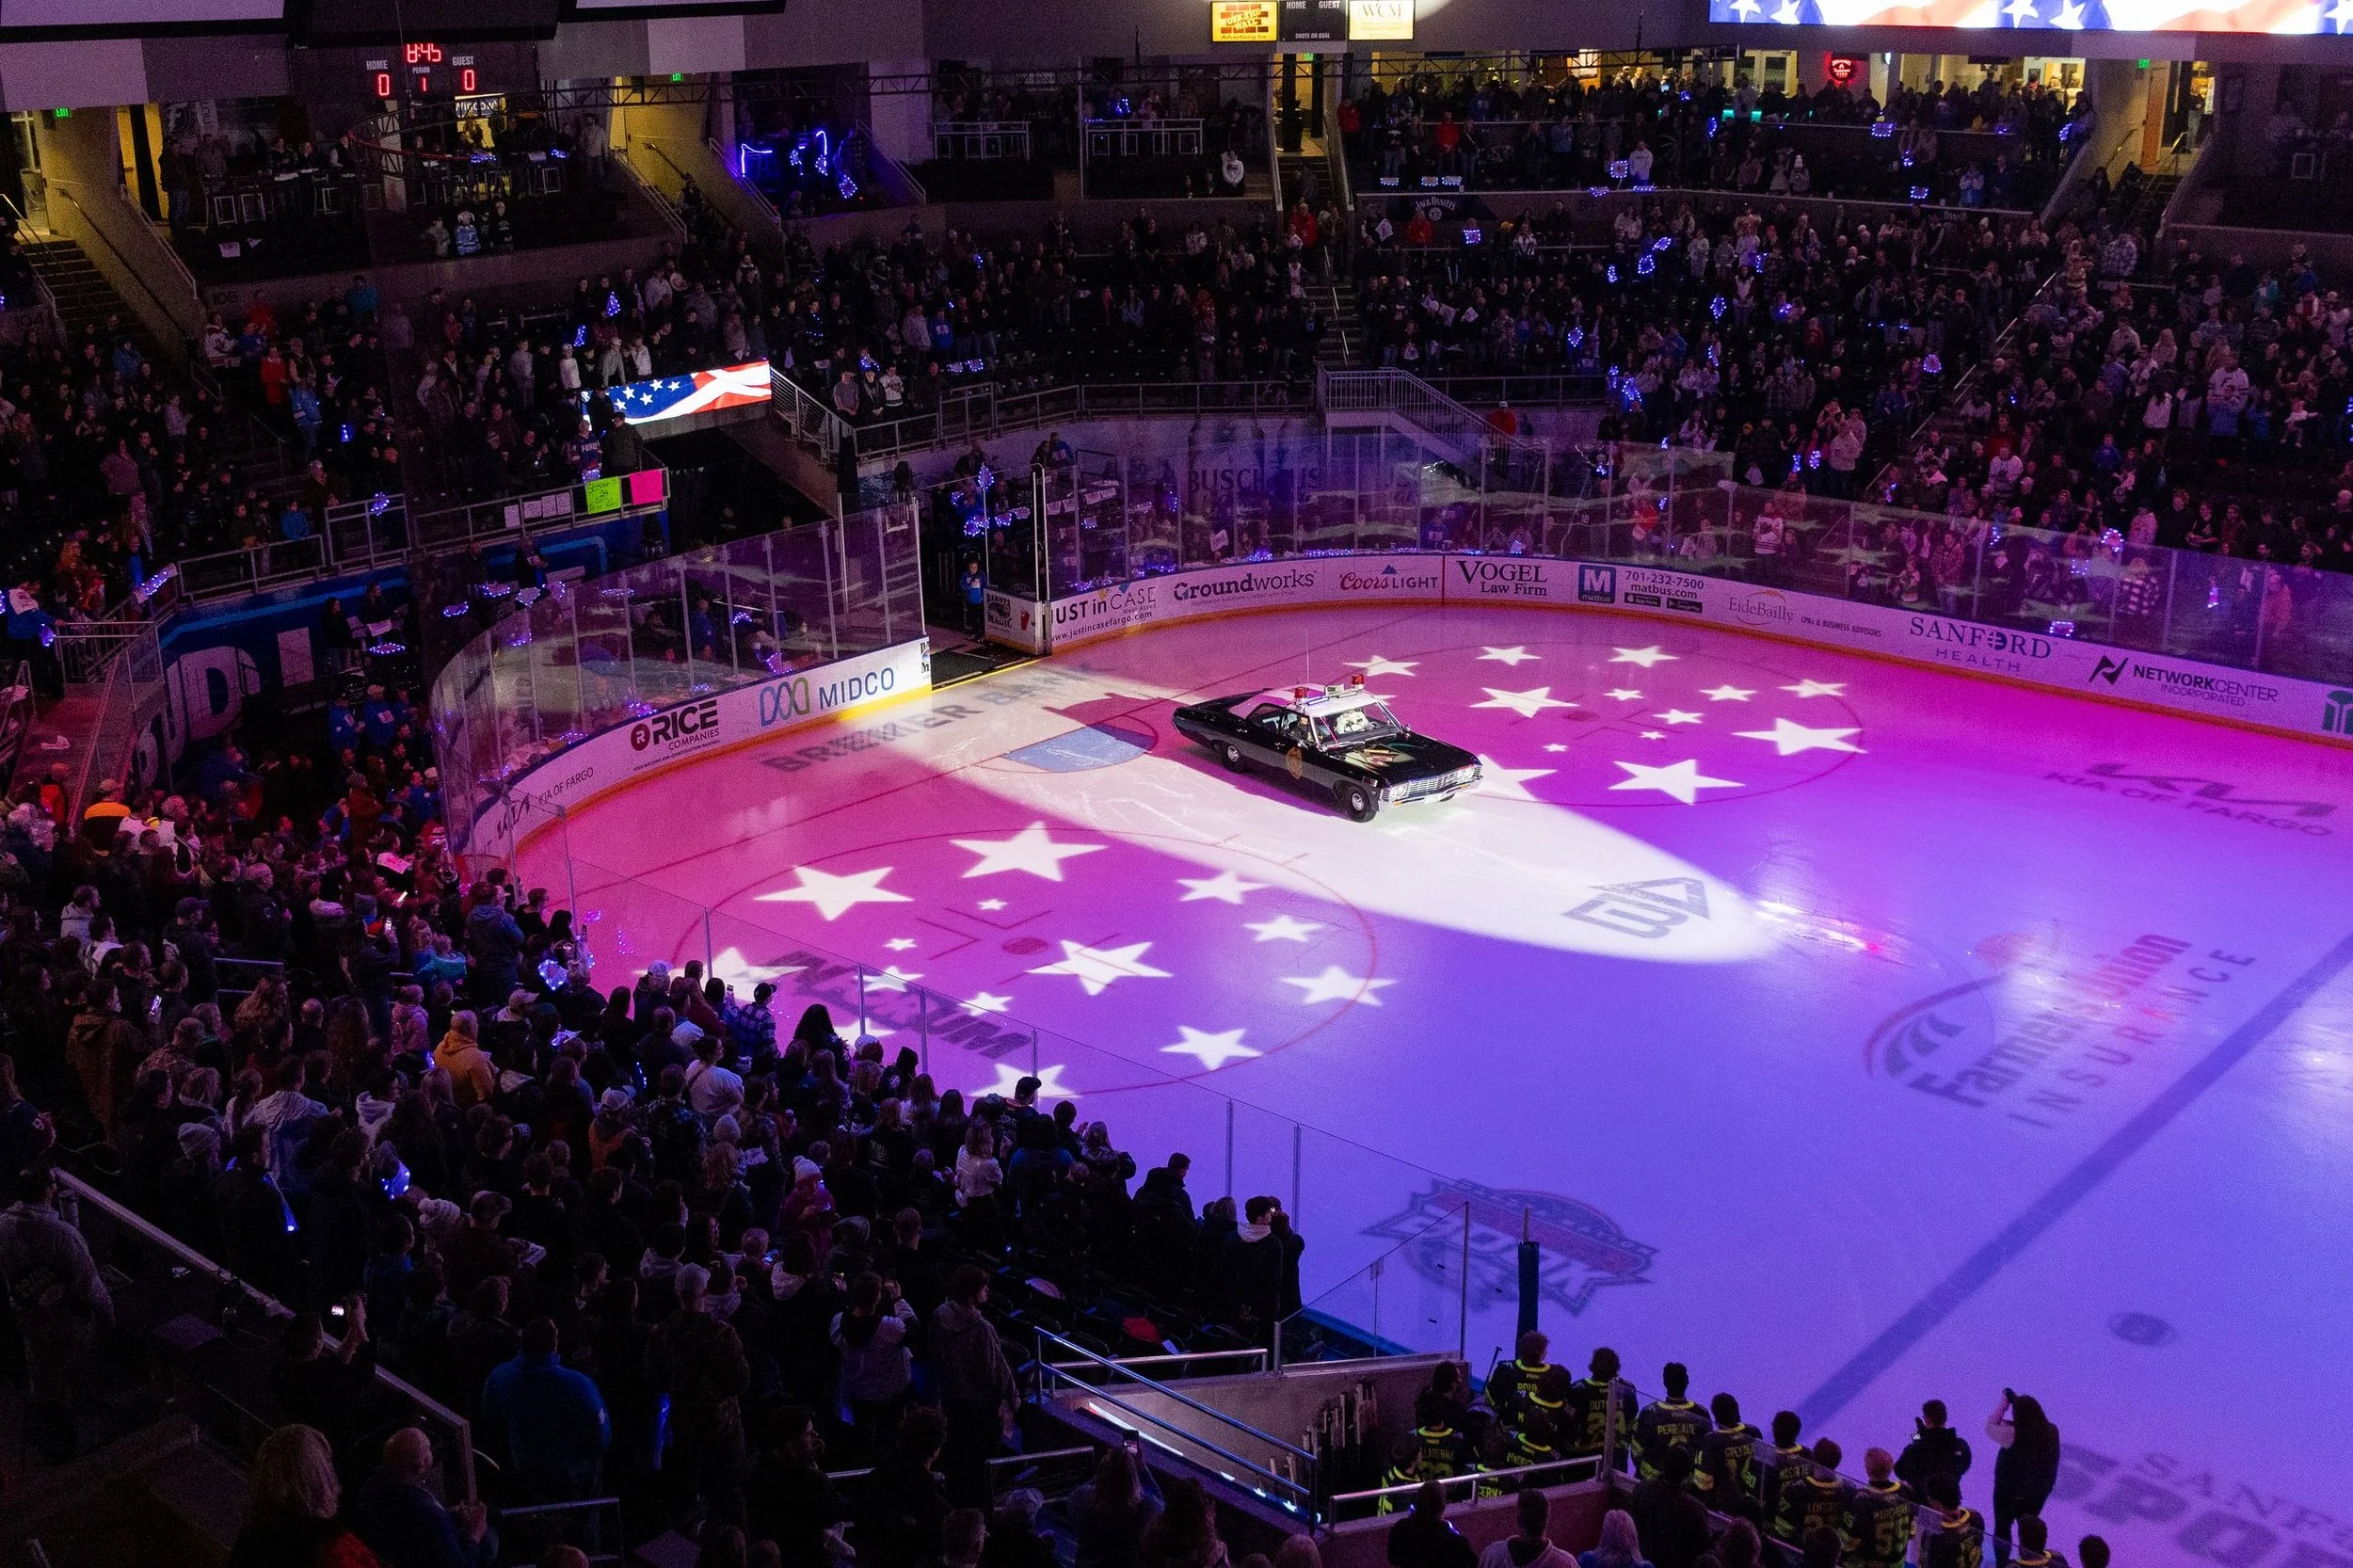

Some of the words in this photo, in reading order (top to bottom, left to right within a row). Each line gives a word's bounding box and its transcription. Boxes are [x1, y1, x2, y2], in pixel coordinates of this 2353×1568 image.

[1286, 1, 1306, 9] HOME
[1319, 1, 1340, 9] GUEST
[366, 60, 388, 71] HOME
[453, 56, 474, 66] GUEST
[378, 74, 390, 95] 0
[422, 77, 427, 91] 1
[464, 70, 474, 90] 0
[1188, 469, 1264, 493] BUSCH
[1339, 572, 1389, 590] Coors
[1392, 577, 1438, 588] LIGHT
[1456, 561, 1548, 584] VOGEL
[1625, 570, 1705, 590] 701-232-7500
[1174, 569, 1314, 600] Groundworks
[1481, 582, 1509, 593] Law
[1514, 584, 1547, 596] Firm
[1630, 583, 1698, 600] matbus.com
[1110, 586, 1157, 610] CASE
[1822, 619, 1850, 632] BUSINESS
[1851, 625, 1882, 637] ADVISORS
[1910, 616, 2051, 659] SANFORD
[1936, 647, 2021, 673] HEALTH
[819, 666, 894, 710] MIDCO
[2161, 683, 2246, 707] INCORPORATED
[651, 699, 718, 745] RICE
[668, 728, 720, 751] COMPANIES
[537, 790, 552, 804] KIA
[552, 782, 565, 796] OF
[566, 766, 594, 789] FARGO
[2185, 801, 2332, 836] FARGO
[2007, 948, 2257, 1128] INSURANCE
